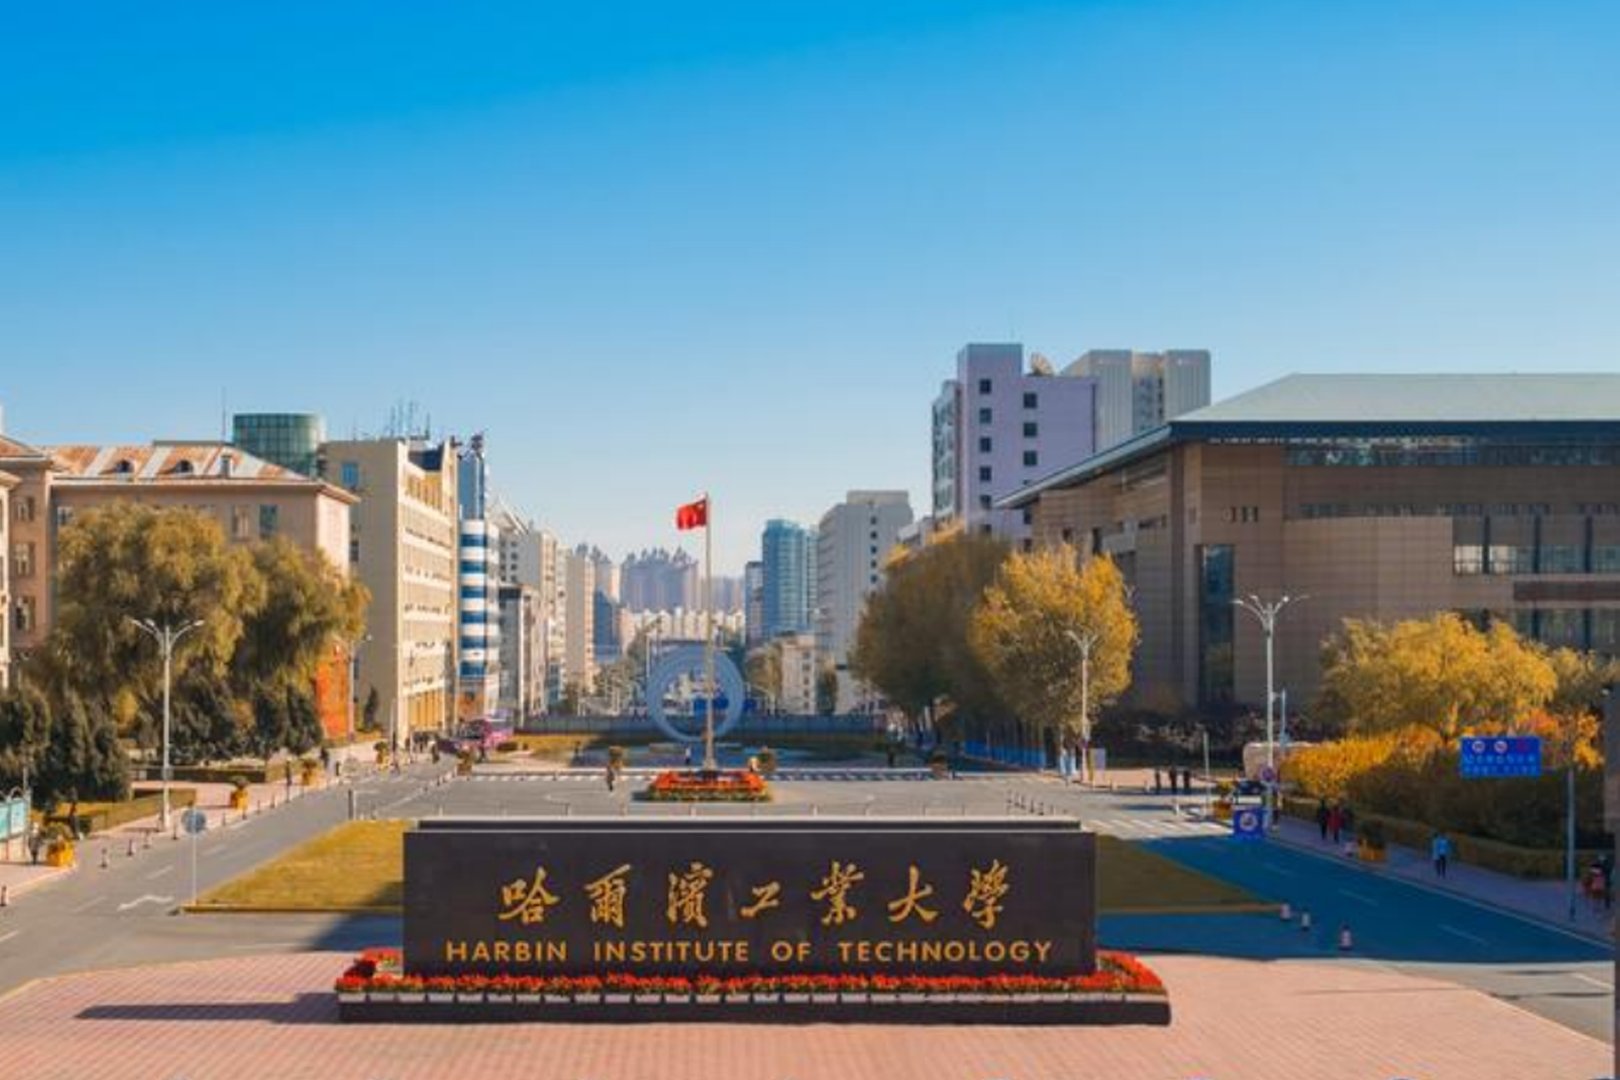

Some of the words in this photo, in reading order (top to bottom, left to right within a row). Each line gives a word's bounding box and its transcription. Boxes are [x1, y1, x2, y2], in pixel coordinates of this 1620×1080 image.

[445, 940, 568, 963] HARBIN
[593, 940, 750, 963] INSTITUTE
[770, 940, 812, 963] OF
[837, 940, 1052, 963] TECHNOLOGY
